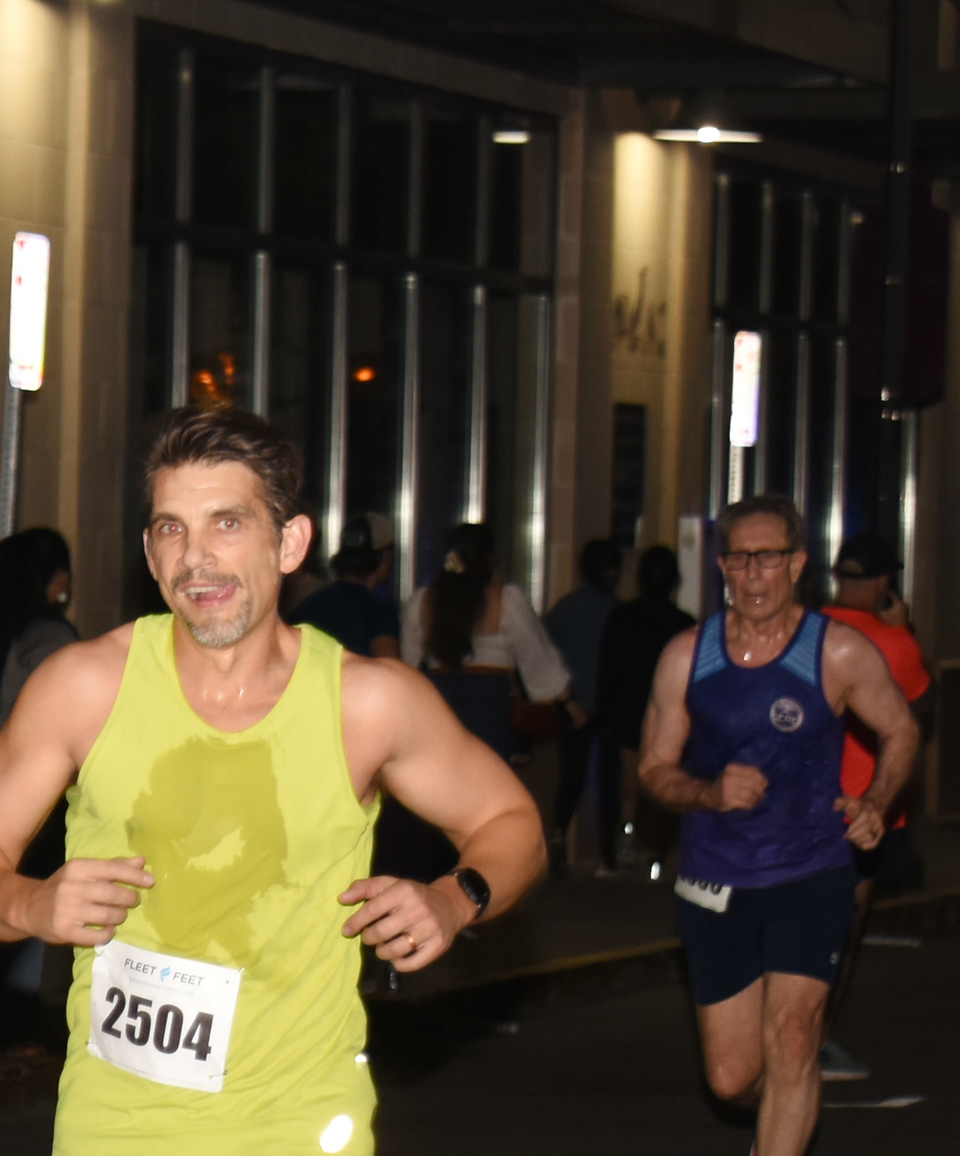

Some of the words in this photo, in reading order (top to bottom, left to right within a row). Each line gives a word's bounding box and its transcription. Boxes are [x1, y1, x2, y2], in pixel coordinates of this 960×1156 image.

[124, 958, 157, 976] FLEET
[172, 971, 205, 987] FEET
[101, 986, 214, 1062] 2504
